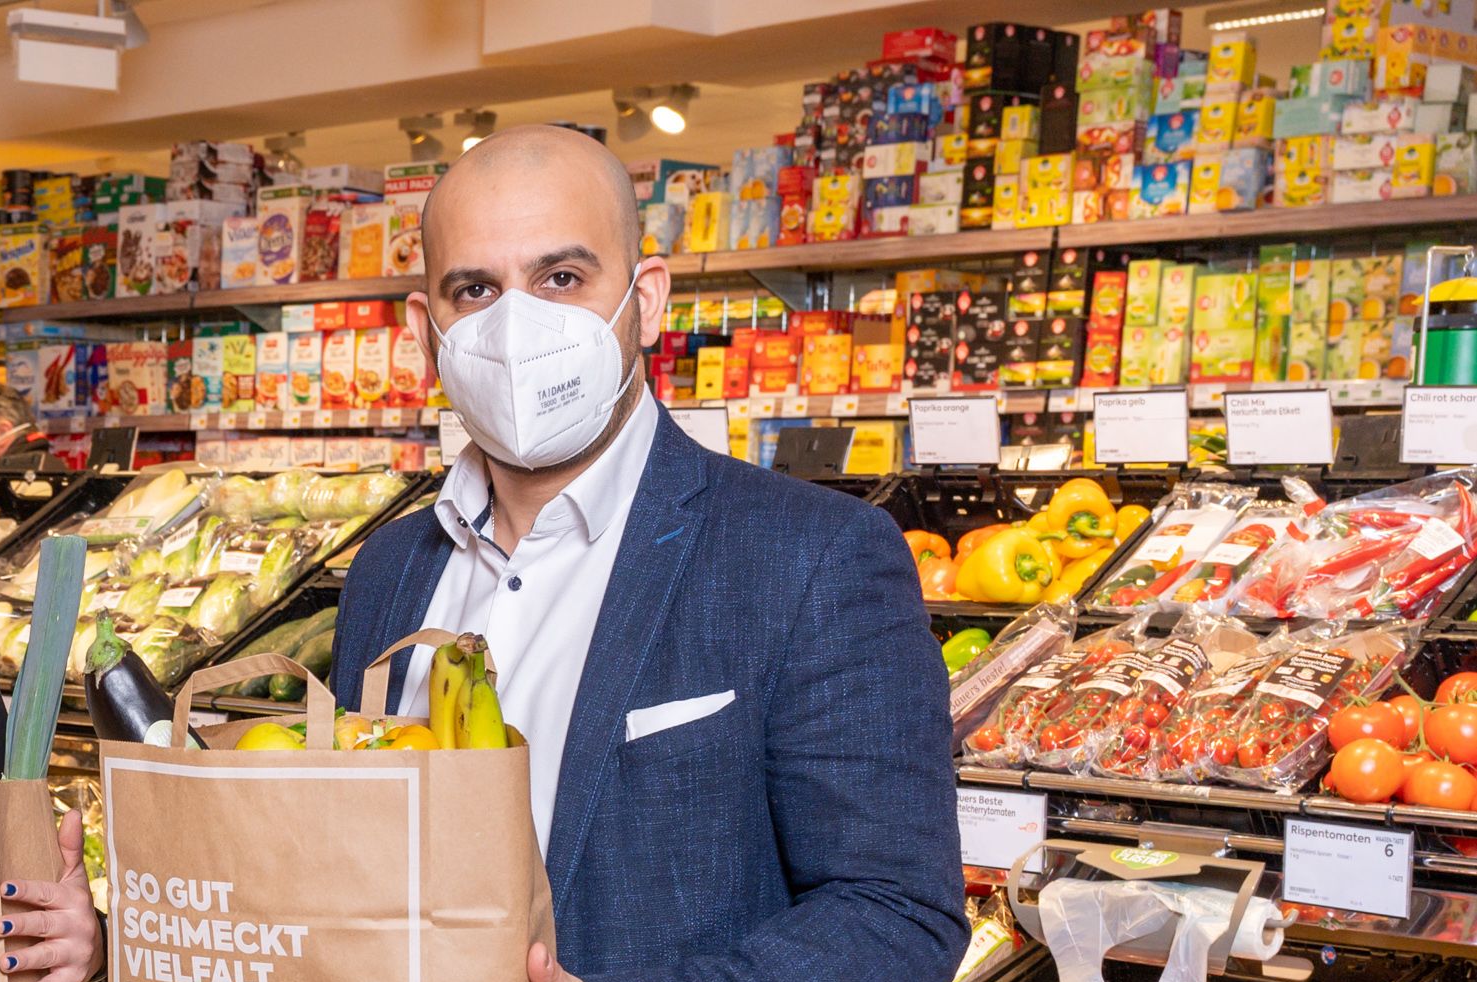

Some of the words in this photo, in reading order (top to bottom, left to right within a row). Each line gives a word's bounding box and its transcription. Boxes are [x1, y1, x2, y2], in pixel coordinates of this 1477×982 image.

[409, 177, 435, 190] PACK
[537, 376, 581, 401] TAIDAKANG
[1098, 398, 1127, 407] Paprika
[1128, 397, 1145, 407] gelb
[1230, 398, 1254, 407] Chili
[1256, 398, 1266, 406] Mix
[1410, 393, 1431, 402] Chili
[1433, 394, 1447, 402] rot
[914, 404, 942, 413] Paprika
[943, 404, 970, 413] orange
[1261, 407, 1277, 416] siehe
[1278, 406, 1301, 416] Etikett
[980, 662, 1005, 693] beste!
[979, 796, 1003, 806] Beste
[1291, 825, 1371, 843] Rispentomaten
[1384, 844, 1394, 857] 6
[126, 870, 160, 904] SO
[166, 877, 233, 913] GUT
[124, 907, 308, 957] SCHMECKT
